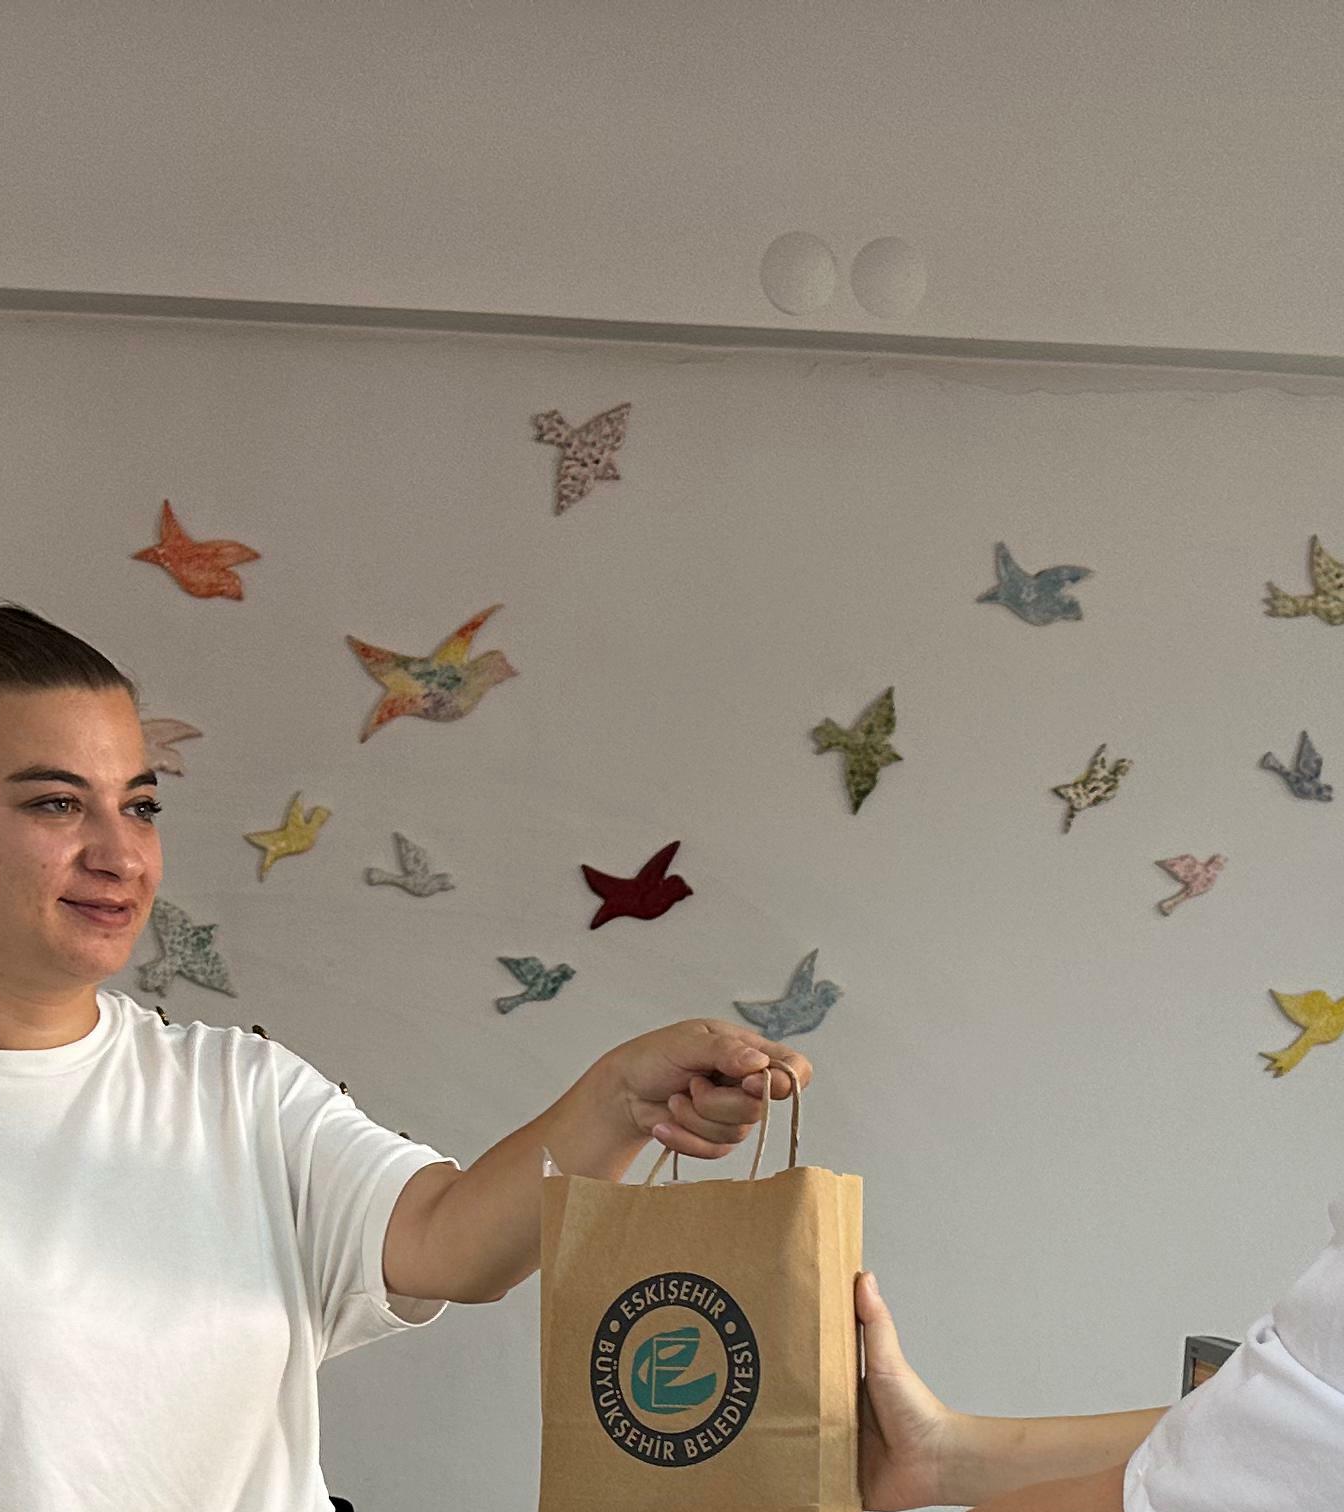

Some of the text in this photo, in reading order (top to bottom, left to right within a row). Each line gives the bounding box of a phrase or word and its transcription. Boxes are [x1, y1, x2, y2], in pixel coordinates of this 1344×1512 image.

[619, 1277, 727, 1321] ESKİŞEHİR
[594, 1339, 754, 1461] BÜYÜKŞEHİR BELEDİYESİ
